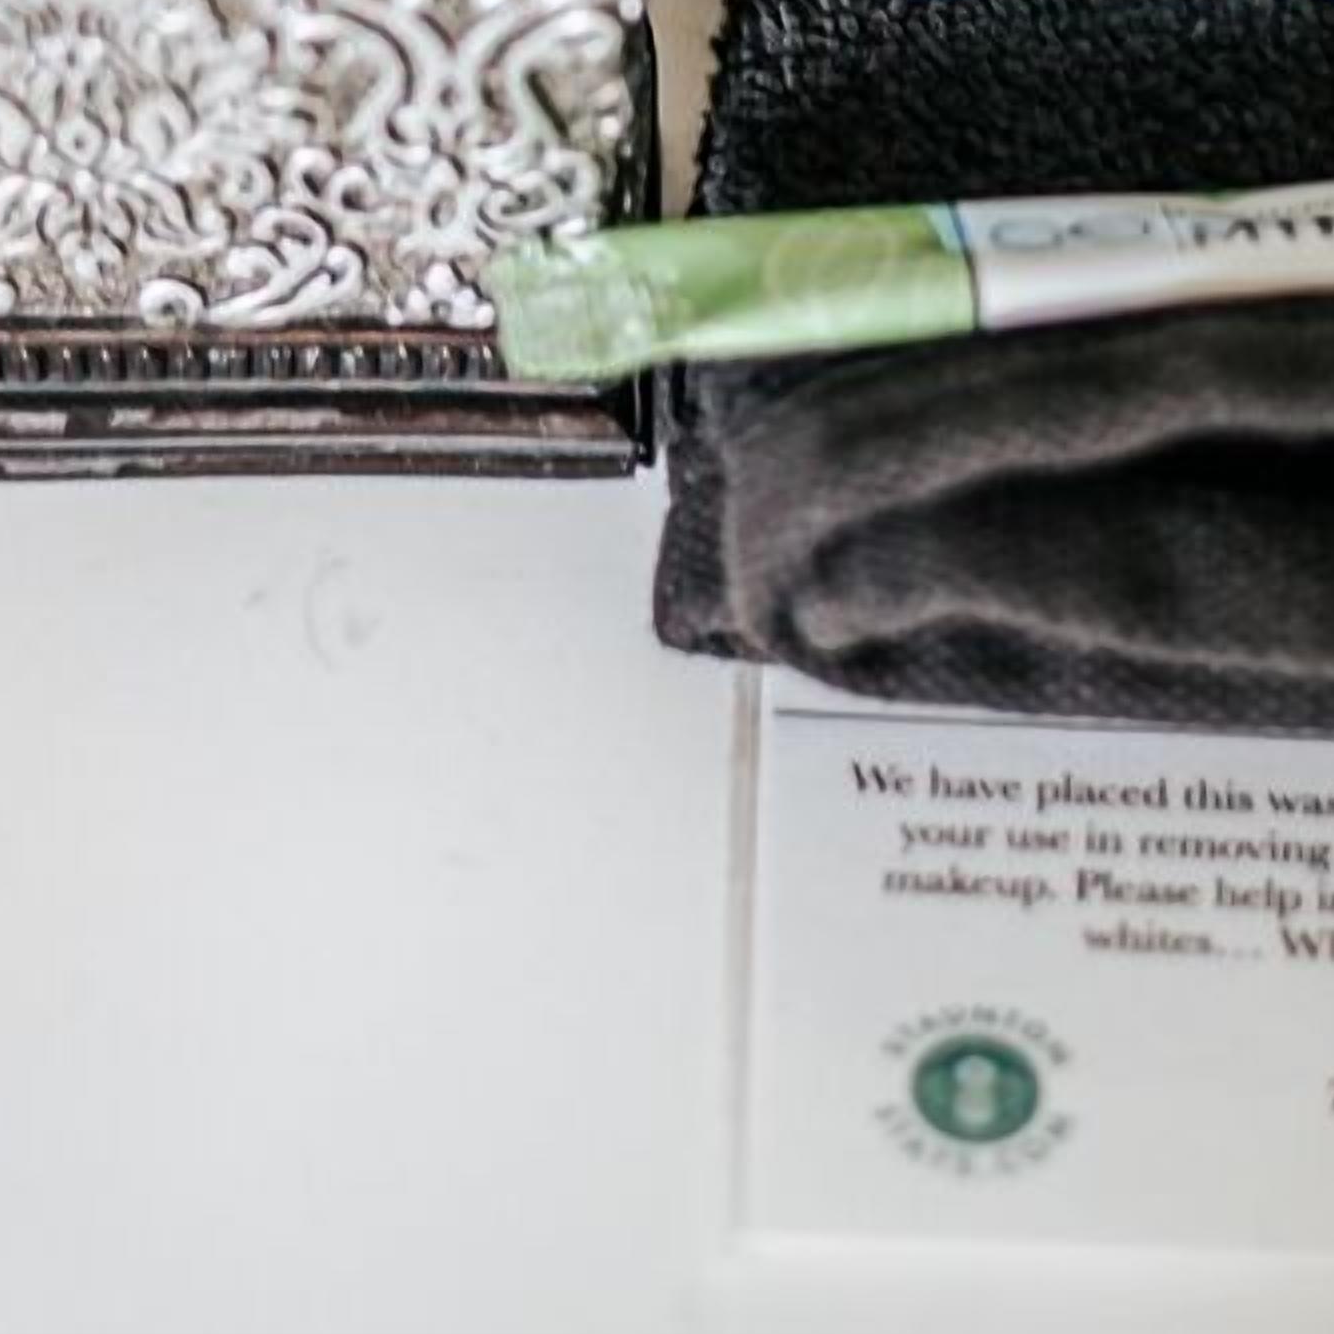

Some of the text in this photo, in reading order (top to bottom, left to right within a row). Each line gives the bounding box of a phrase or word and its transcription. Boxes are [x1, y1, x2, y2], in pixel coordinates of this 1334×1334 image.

[851, 759, 914, 795] We
[928, 764, 1022, 800] have
[1036, 770, 1169, 813] placed
[1183, 777, 1255, 812] this
[898, 821, 993, 853] your
[1006, 825, 1070, 852] use
[1085, 820, 1123, 855] in
[1138, 829, 1332, 871] removing
[880, 867, 1058, 909] makeup.
[1076, 868, 1199, 904] Please
[1215, 877, 1303, 918] help
